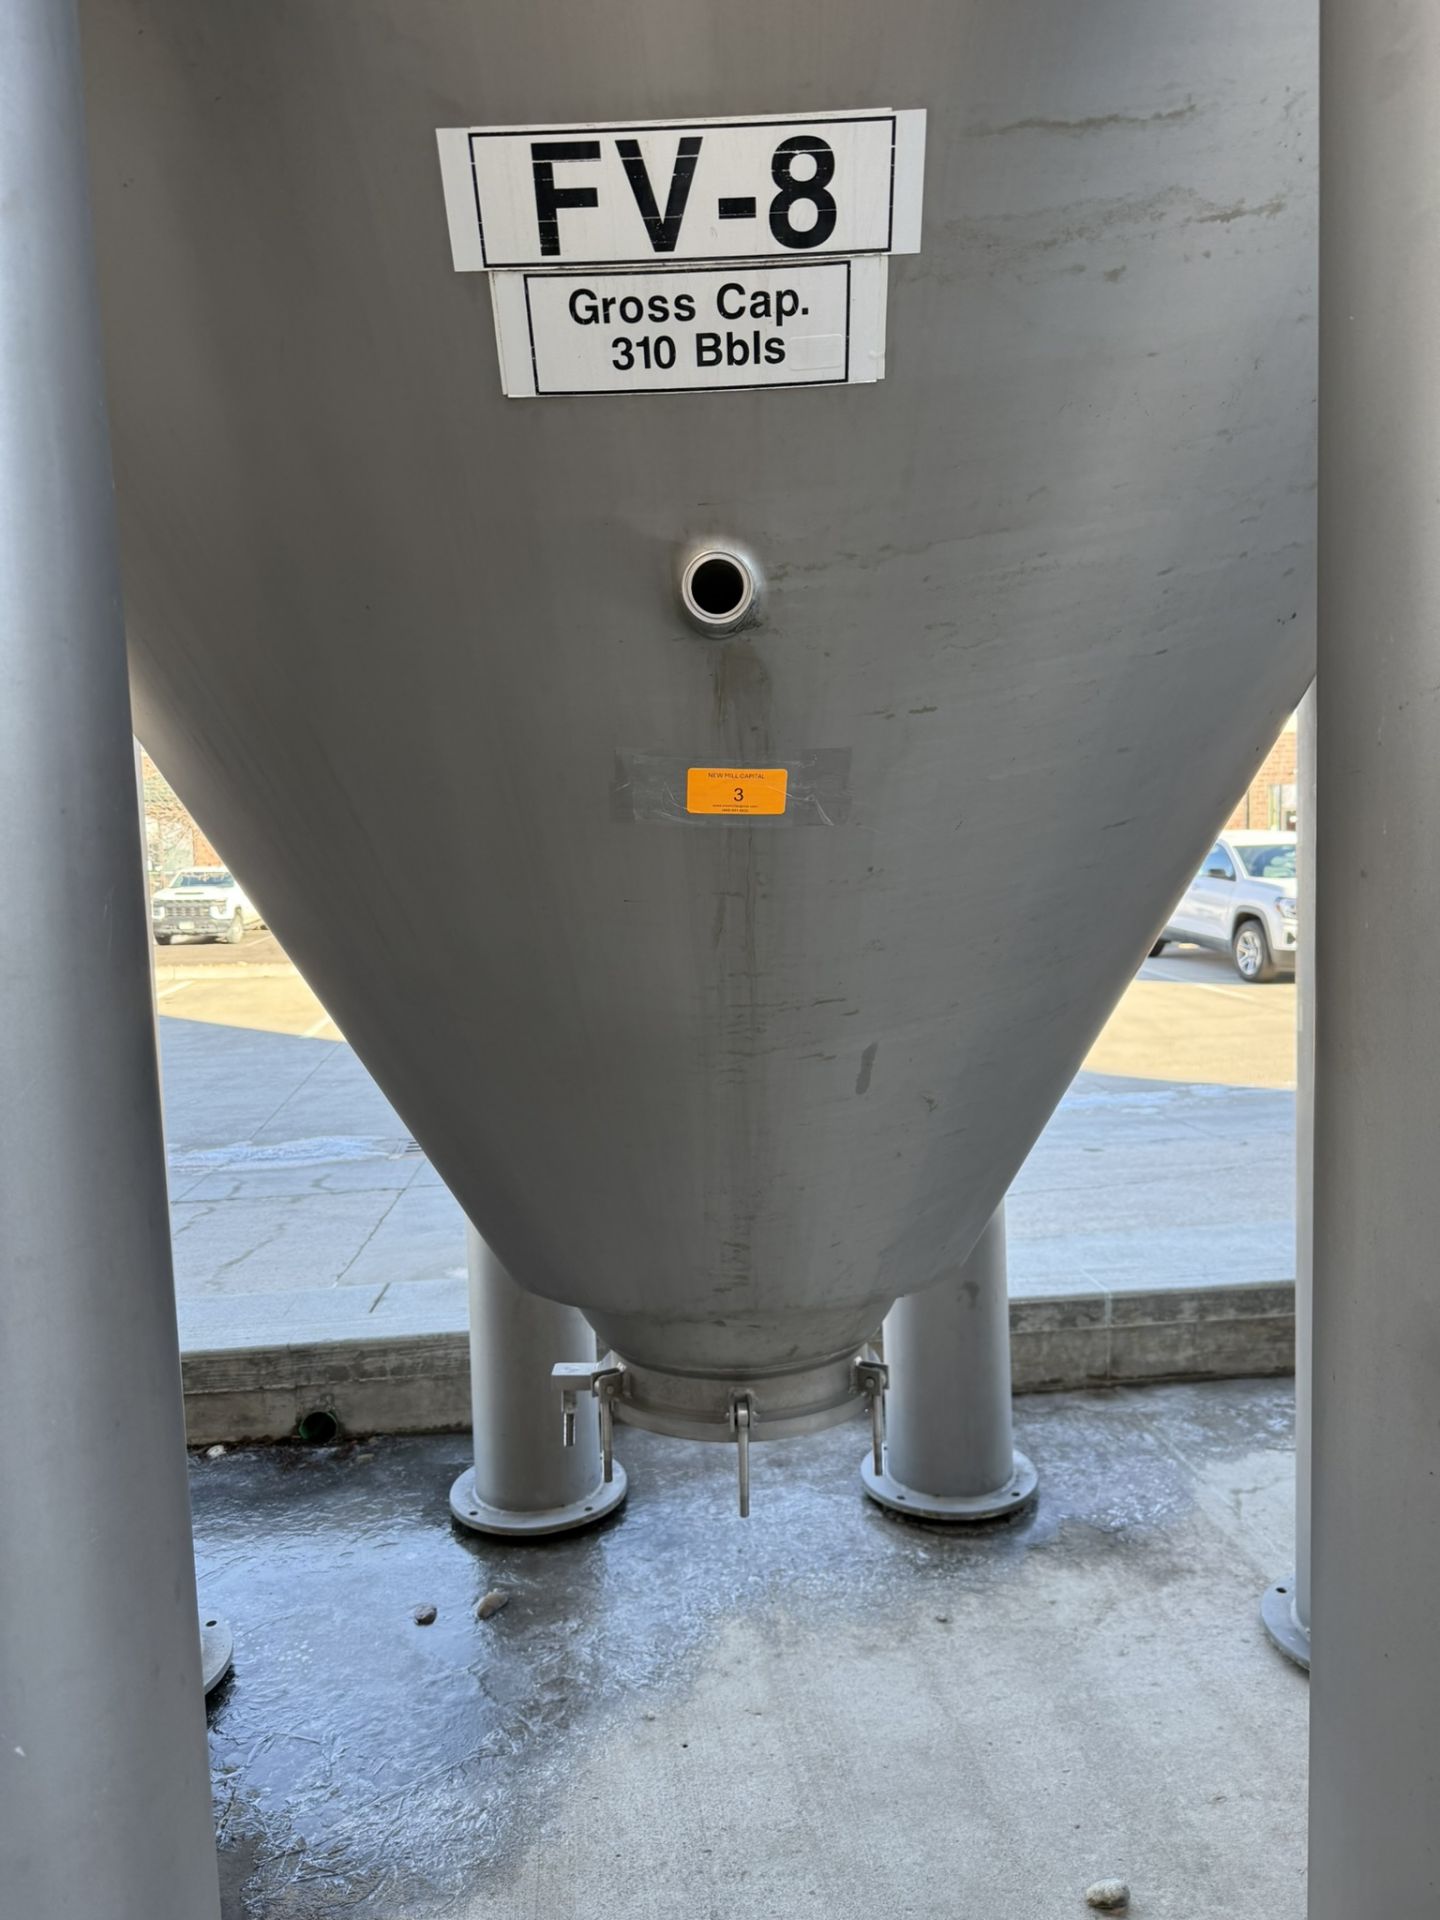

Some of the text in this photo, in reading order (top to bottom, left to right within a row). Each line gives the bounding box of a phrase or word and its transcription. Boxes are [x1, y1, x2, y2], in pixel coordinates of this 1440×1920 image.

[531, 135, 837, 256] FV-8
[568, 282, 810, 327] Gross Cap.
[611, 331, 786, 370] 310 Bbls
[734, 788, 744, 802] 3
